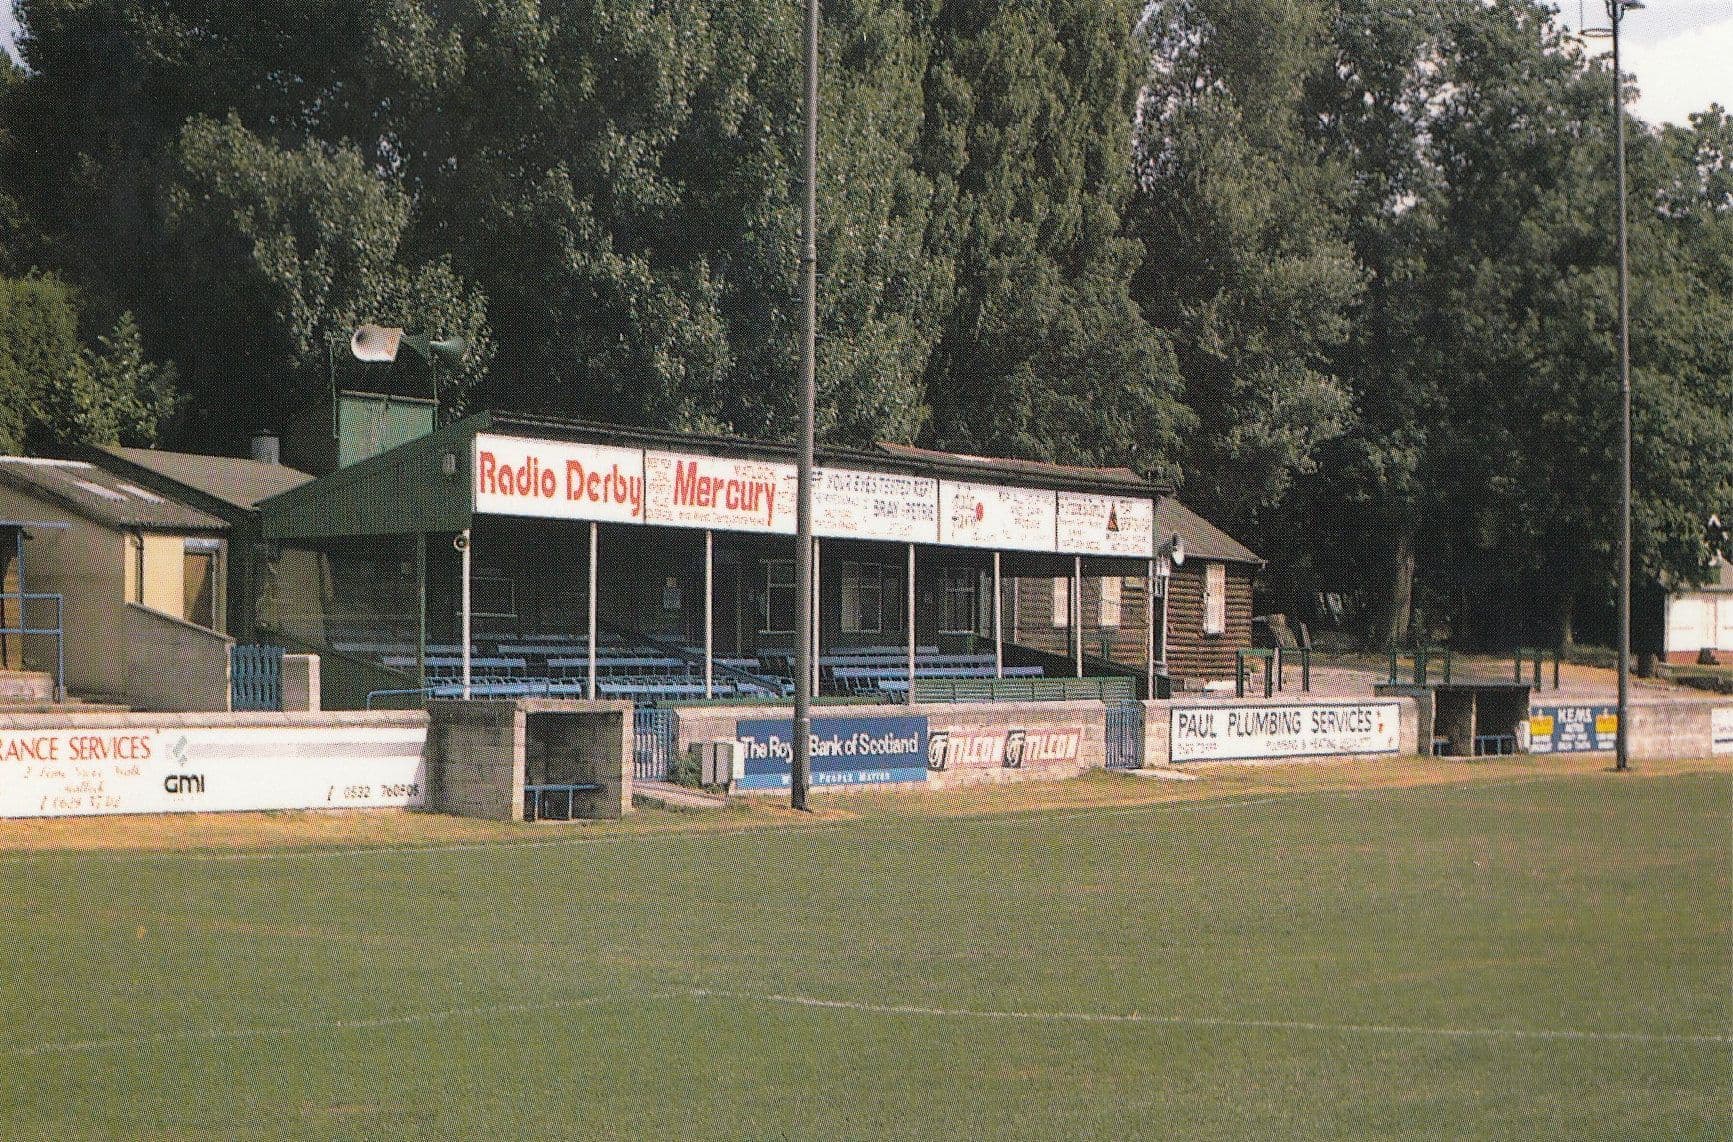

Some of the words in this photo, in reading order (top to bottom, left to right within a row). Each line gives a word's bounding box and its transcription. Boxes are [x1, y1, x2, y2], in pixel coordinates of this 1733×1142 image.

[479, 451, 556, 498] Radio
[566, 459, 643, 517] Derby
[673, 460, 777, 527] Mercury
[1178, 713, 1217, 739] PAUL
[1228, 711, 1301, 737] PLUMBING
[1311, 709, 1373, 734] SERVICES
[69, 736, 151, 761] SERVICES
[740, 736, 768, 759] The
[769, 734, 794, 763] Roy
[809, 734, 844, 757] Bank
[845, 732, 858, 755] of
[859, 732, 919, 755] Scotland
